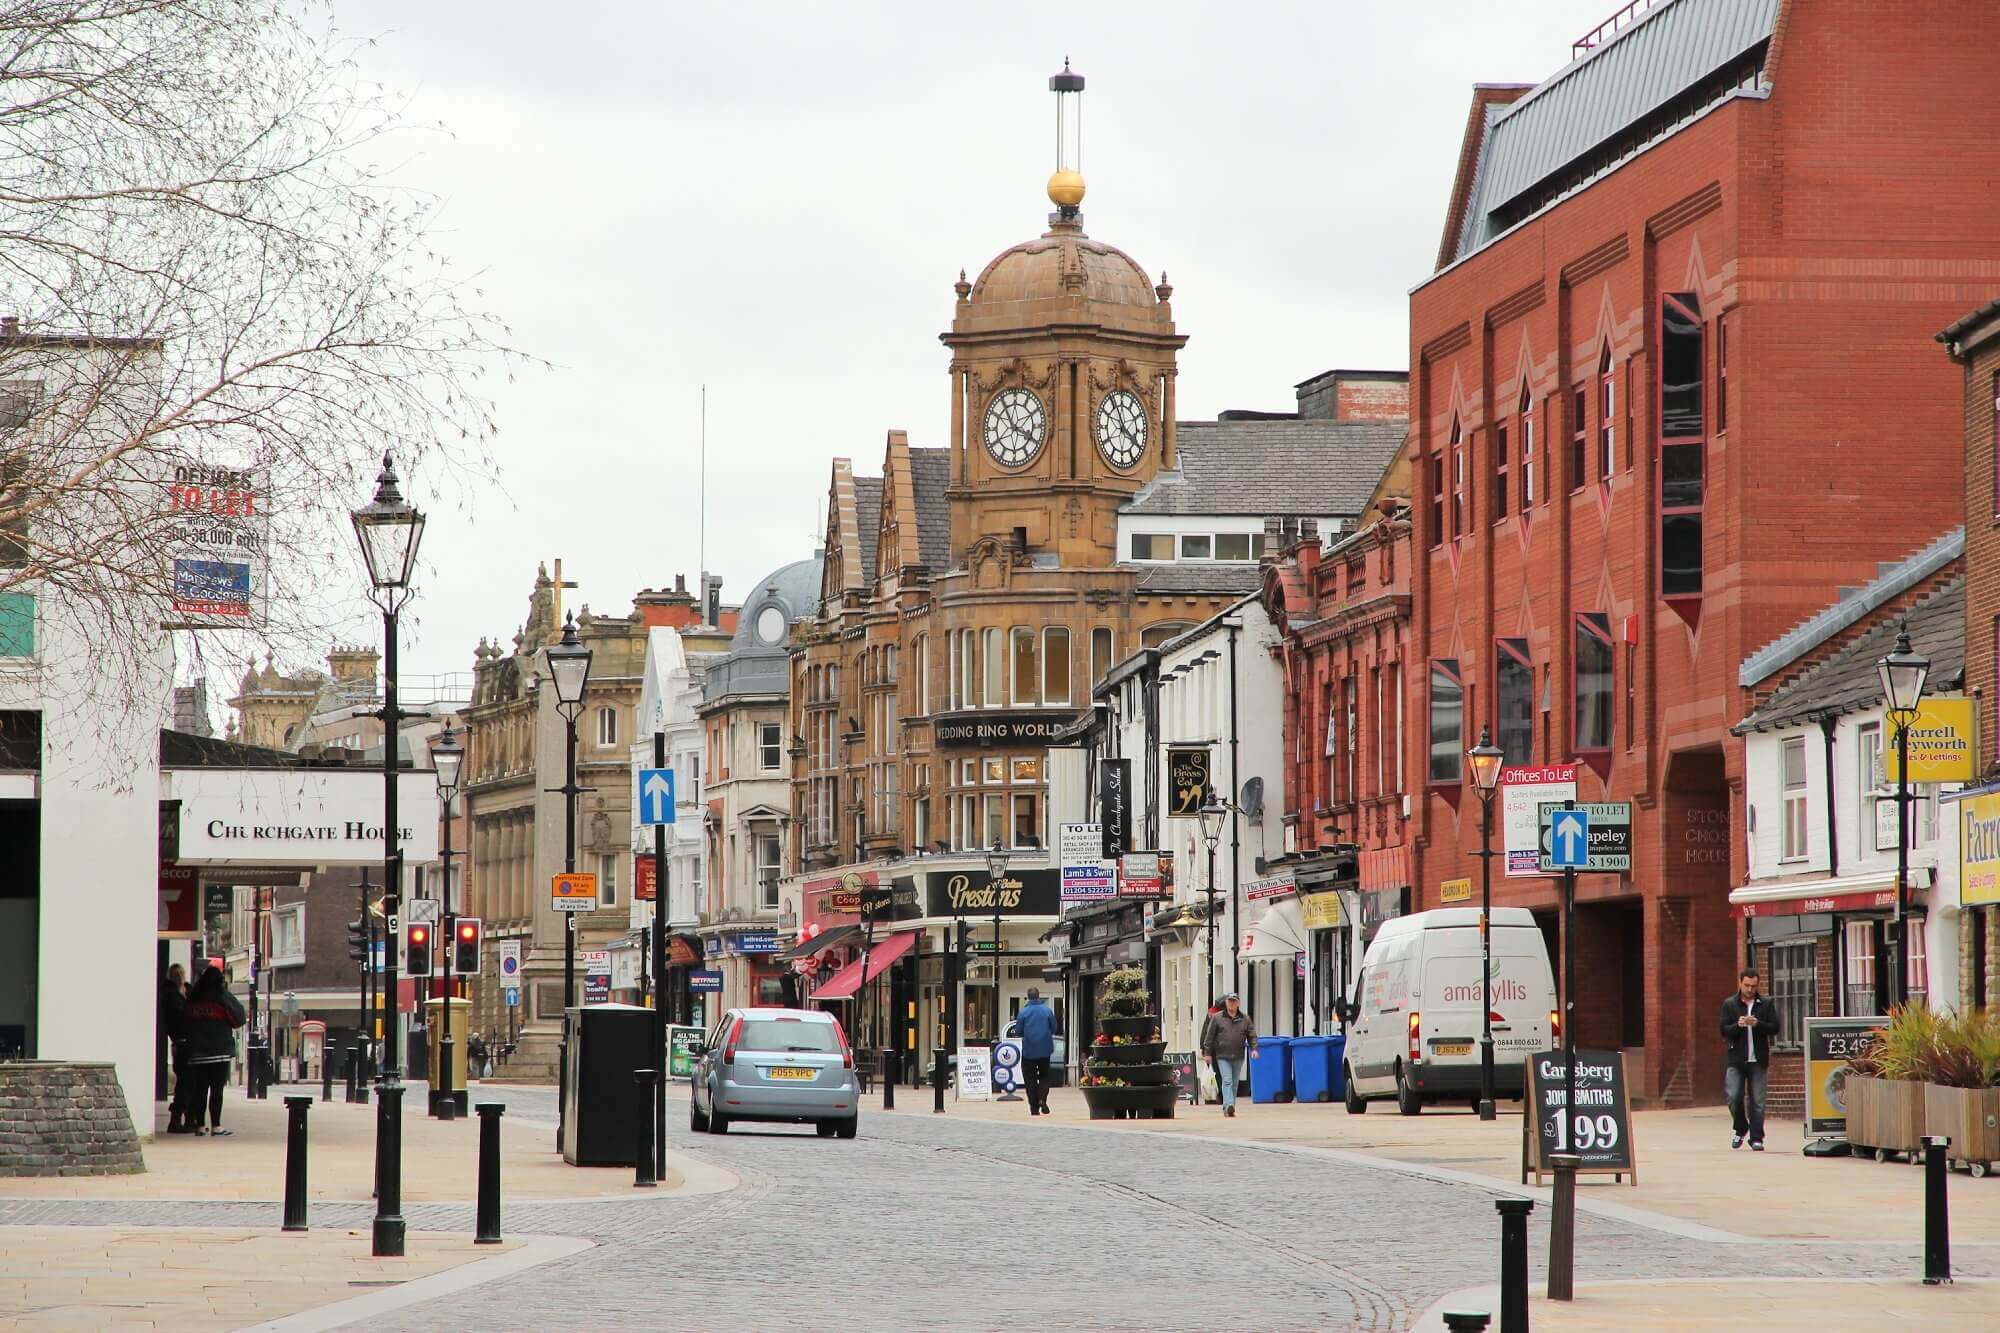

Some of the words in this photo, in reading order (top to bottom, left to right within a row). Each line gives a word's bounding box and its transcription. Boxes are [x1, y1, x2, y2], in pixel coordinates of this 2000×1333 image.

[169, 485, 201, 513] TO
[211, 488, 257, 516] LET
[937, 725, 973, 740] WEDDING
[977, 724, 1008, 737] RING
[1012, 723, 1063, 736] WORLD
[1919, 753, 1928, 761] &
[1929, 752, 1962, 762] Lettings
[1109, 768, 1121, 792] Salon
[1173, 768, 1202, 777] Brass
[1506, 770, 1541, 783] Offices
[1542, 768, 1556, 781] To
[1557, 768, 1574, 781] Let
[1177, 776, 1194, 786] Cat
[1511, 791, 1529, 799] Suites
[1591, 806, 1604, 815] TO
[1606, 805, 1626, 815] LET
[1687, 808, 1730, 824] STON
[1109, 801, 1124, 835] Churchgate
[1067, 825, 1083, 833] TO
[1087, 825, 1102, 833] LE
[1587, 829, 1627, 844] apeley
[1110, 842, 1121, 854] The
[1600, 856, 1627, 867] 1900
[1686, 848, 1729, 864] HOUS
[1064, 867, 1084, 878] Lamb
[1086, 867, 1094, 876] &
[1094, 867, 1113, 877] Swift
[1247, 883, 1258, 892] The
[1258, 880, 1278, 890] Bolton
[1278, 877, 1295, 886] News
[1443, 979, 1527, 1007] amayllis
[1540, 1060, 1614, 1082] Carsberg
[1574, 1089, 1614, 1105] SMITHS
